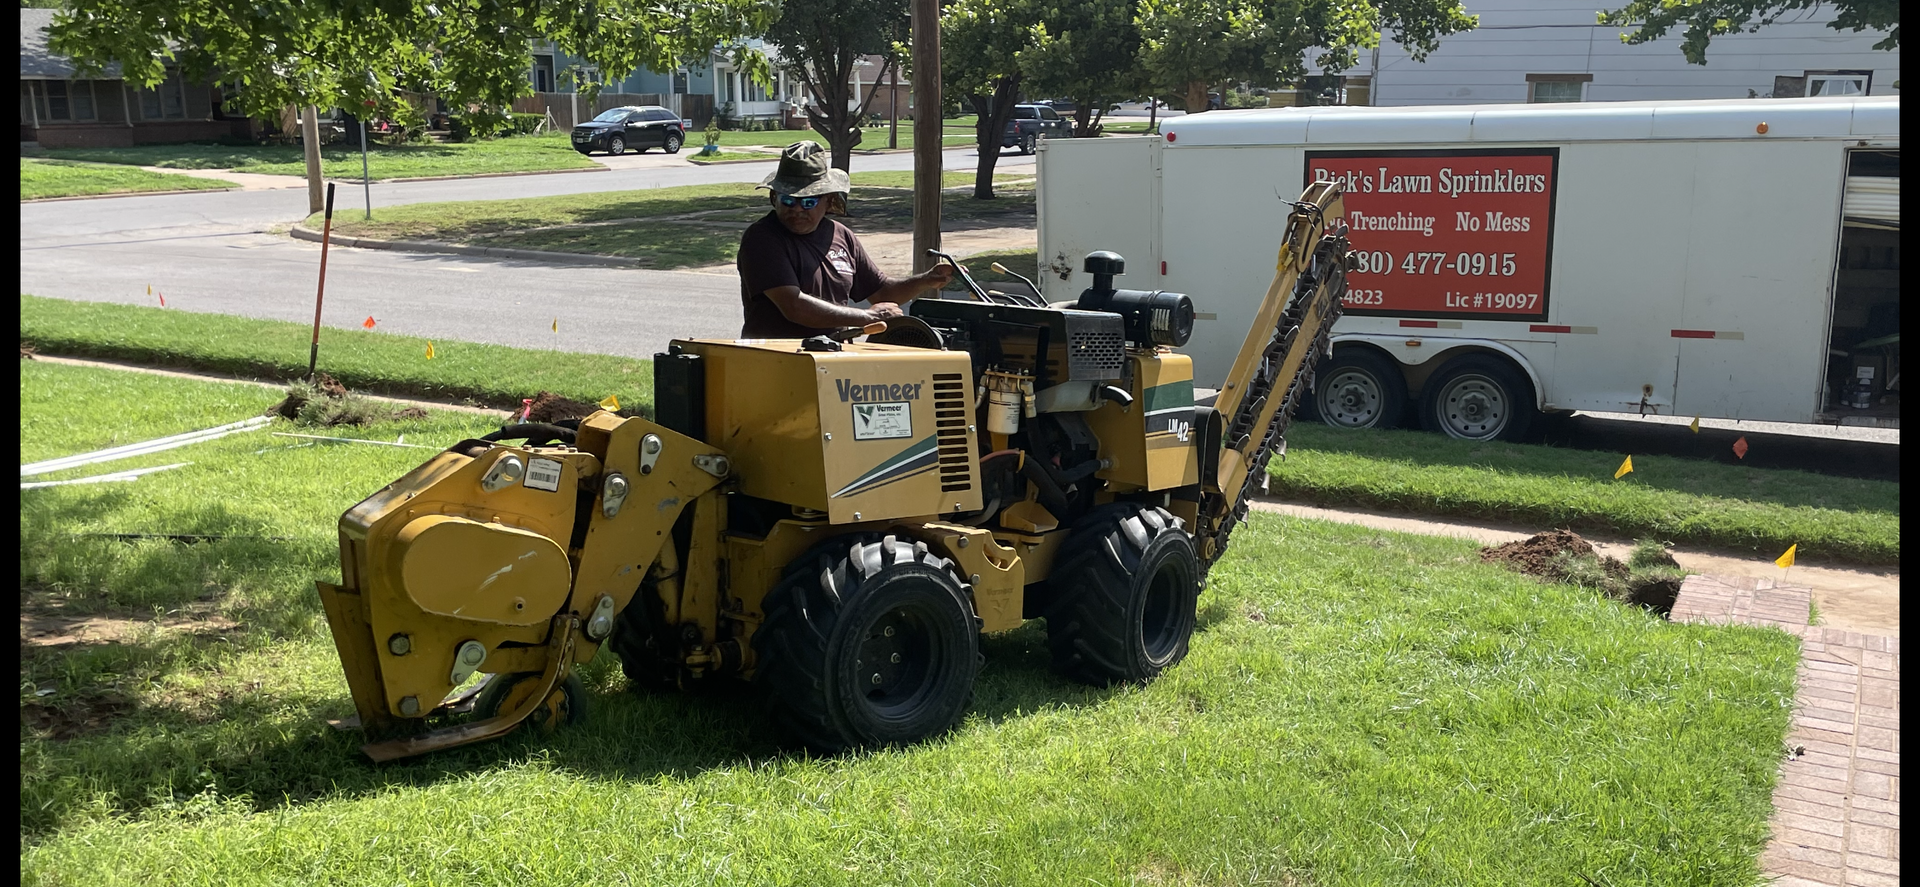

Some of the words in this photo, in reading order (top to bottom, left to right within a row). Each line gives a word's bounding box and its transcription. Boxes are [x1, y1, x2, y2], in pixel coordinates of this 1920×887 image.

[1378, 167, 1432, 194] Lawn
[1438, 167, 1546, 198] Sprinklers
[1351, 211, 1436, 237] Trenching
[1455, 212, 1480, 232] No
[1484, 212, 1531, 233] Mess
[1401, 252, 1516, 277] 477-0915
[1446, 292, 1469, 308] Lic
[1473, 293, 1538, 310] #19097
[835, 378, 922, 403] Vermeer
[1168, 418, 1178, 433] LM
[1177, 421, 1189, 442] 42
